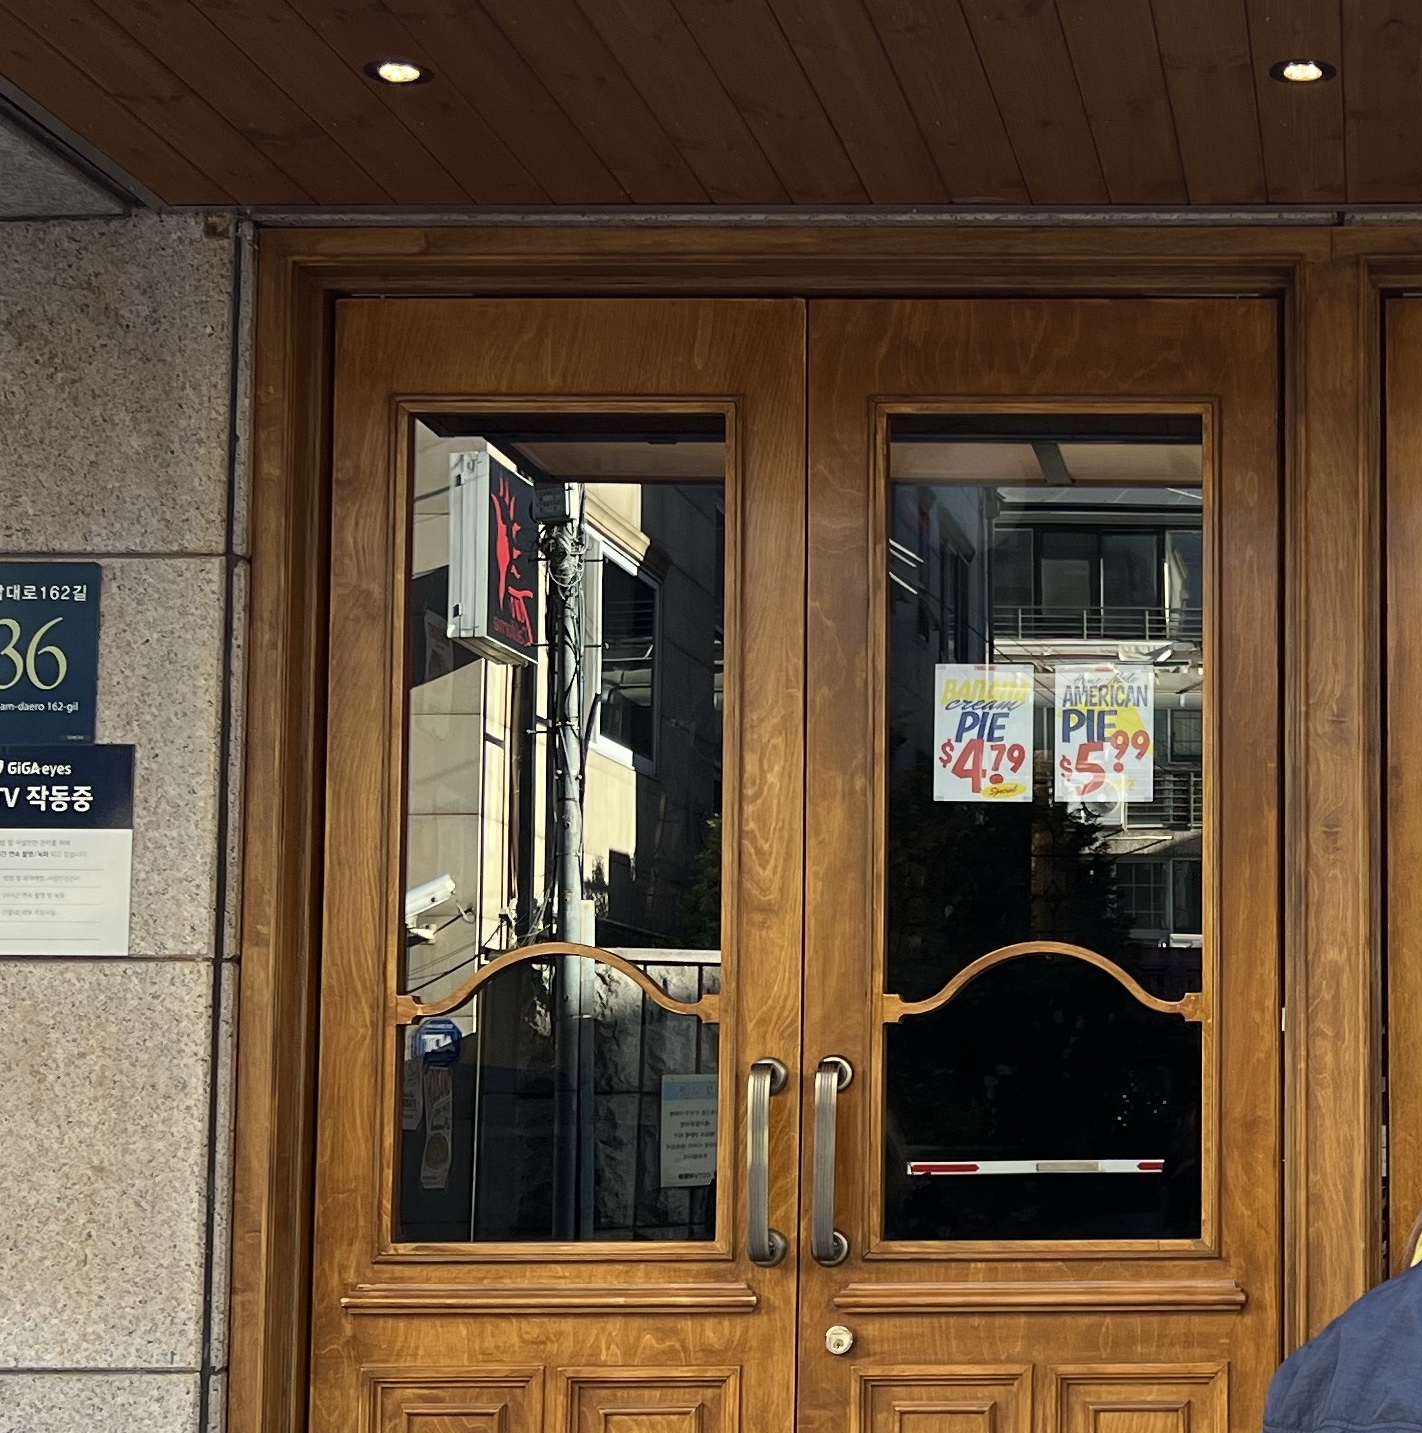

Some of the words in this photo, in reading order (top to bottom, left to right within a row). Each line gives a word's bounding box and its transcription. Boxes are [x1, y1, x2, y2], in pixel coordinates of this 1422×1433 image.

[47, 701, 79, 713] 162-gil
[1063, 684, 1148, 708] AMERICAN
[955, 711, 1009, 743] PIE
[1062, 709, 1117, 743] PIE
[26, 784, 94, 812] 작동중
